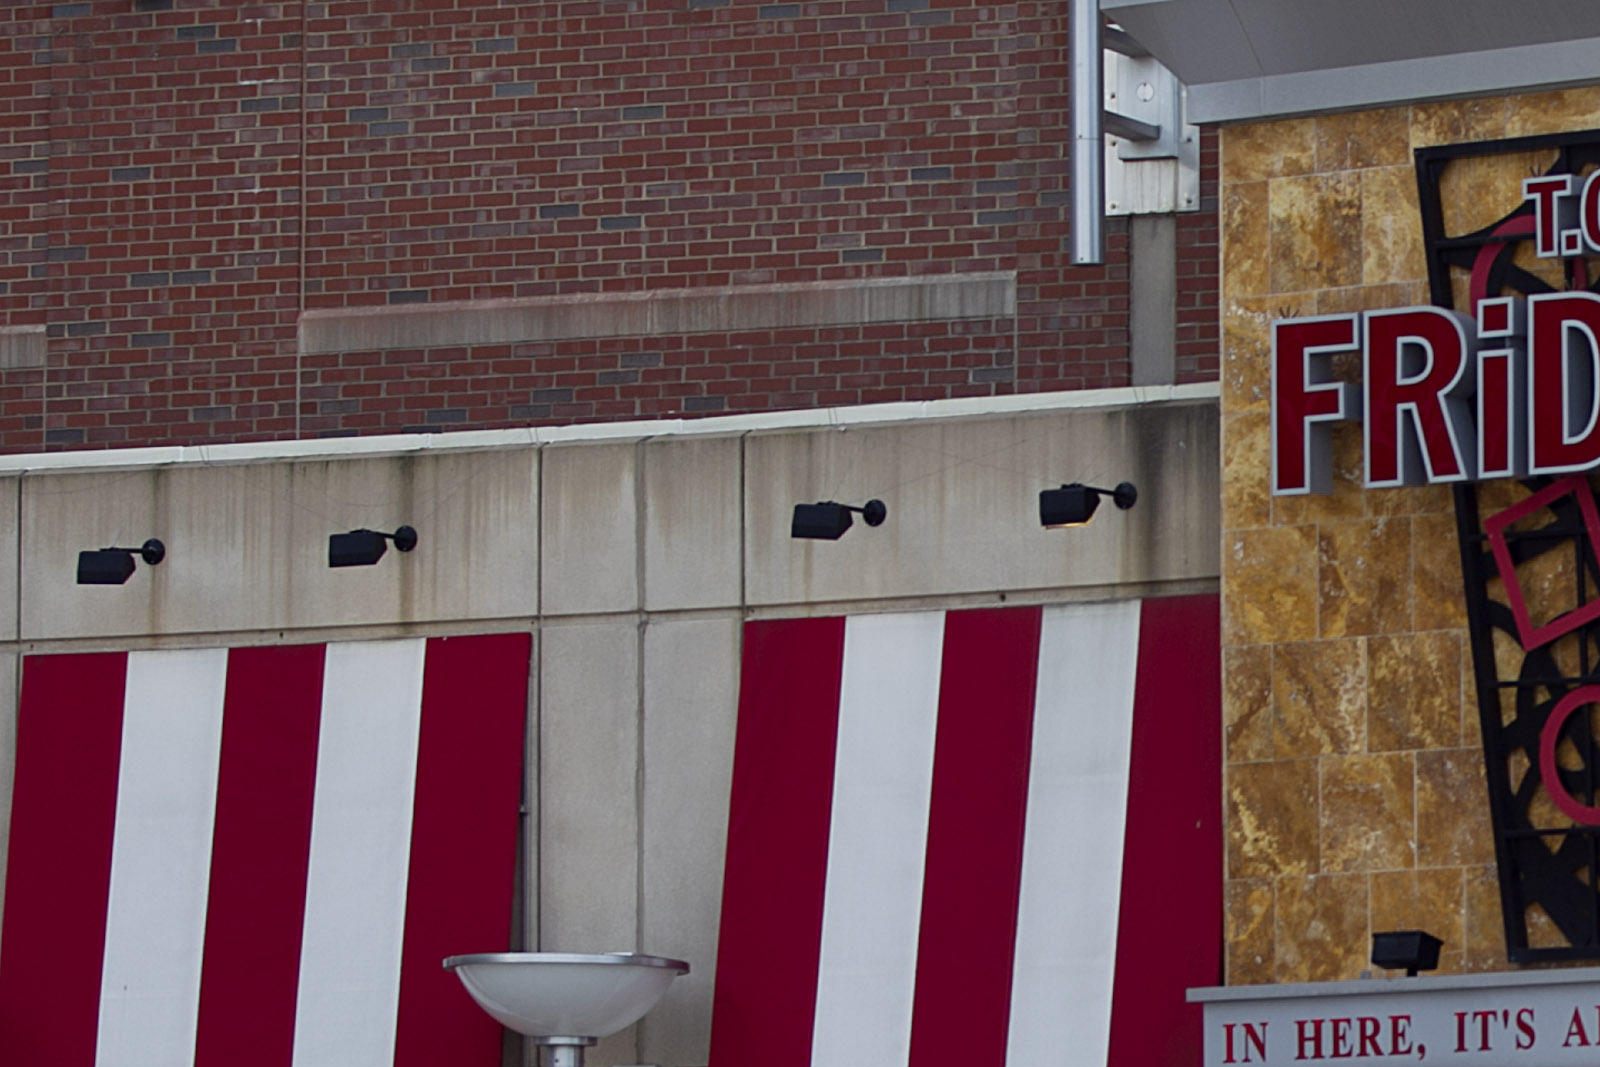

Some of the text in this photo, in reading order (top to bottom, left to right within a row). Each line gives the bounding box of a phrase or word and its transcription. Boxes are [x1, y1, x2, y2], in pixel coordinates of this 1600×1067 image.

[1222, 1023, 1268, 1064] IN
[1294, 1014, 1427, 1061] HERE,
[1454, 1007, 1535, 1052] IT'S
